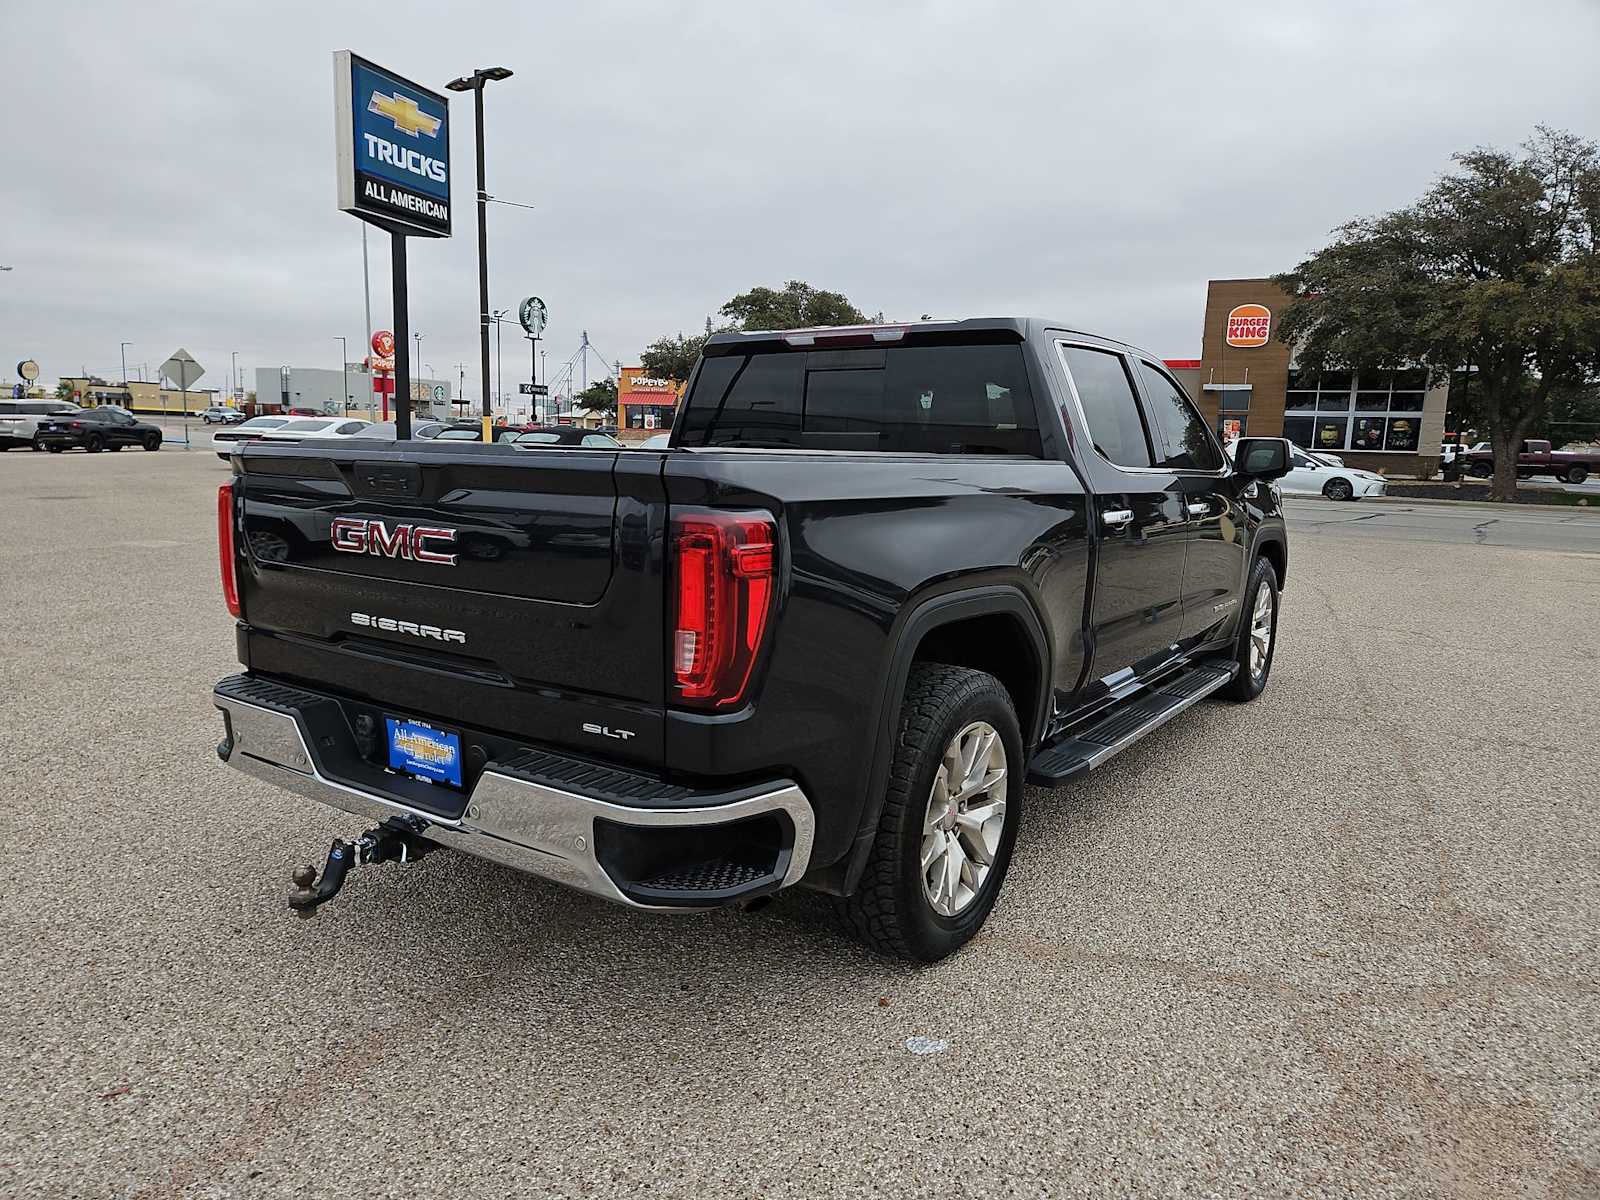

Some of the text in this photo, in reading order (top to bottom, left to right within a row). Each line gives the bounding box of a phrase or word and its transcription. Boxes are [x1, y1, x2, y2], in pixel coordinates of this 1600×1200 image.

[364, 132, 446, 183] TRUCKS
[365, 181, 448, 221] ALL AMERICAN
[1228, 327, 1267, 338] KING
[1229, 318, 1268, 327] BURGER
[331, 516, 457, 566] GMC
[350, 611, 466, 644] SIERRA
[393, 727, 455, 755] All American
[583, 723, 636, 740] SLT
